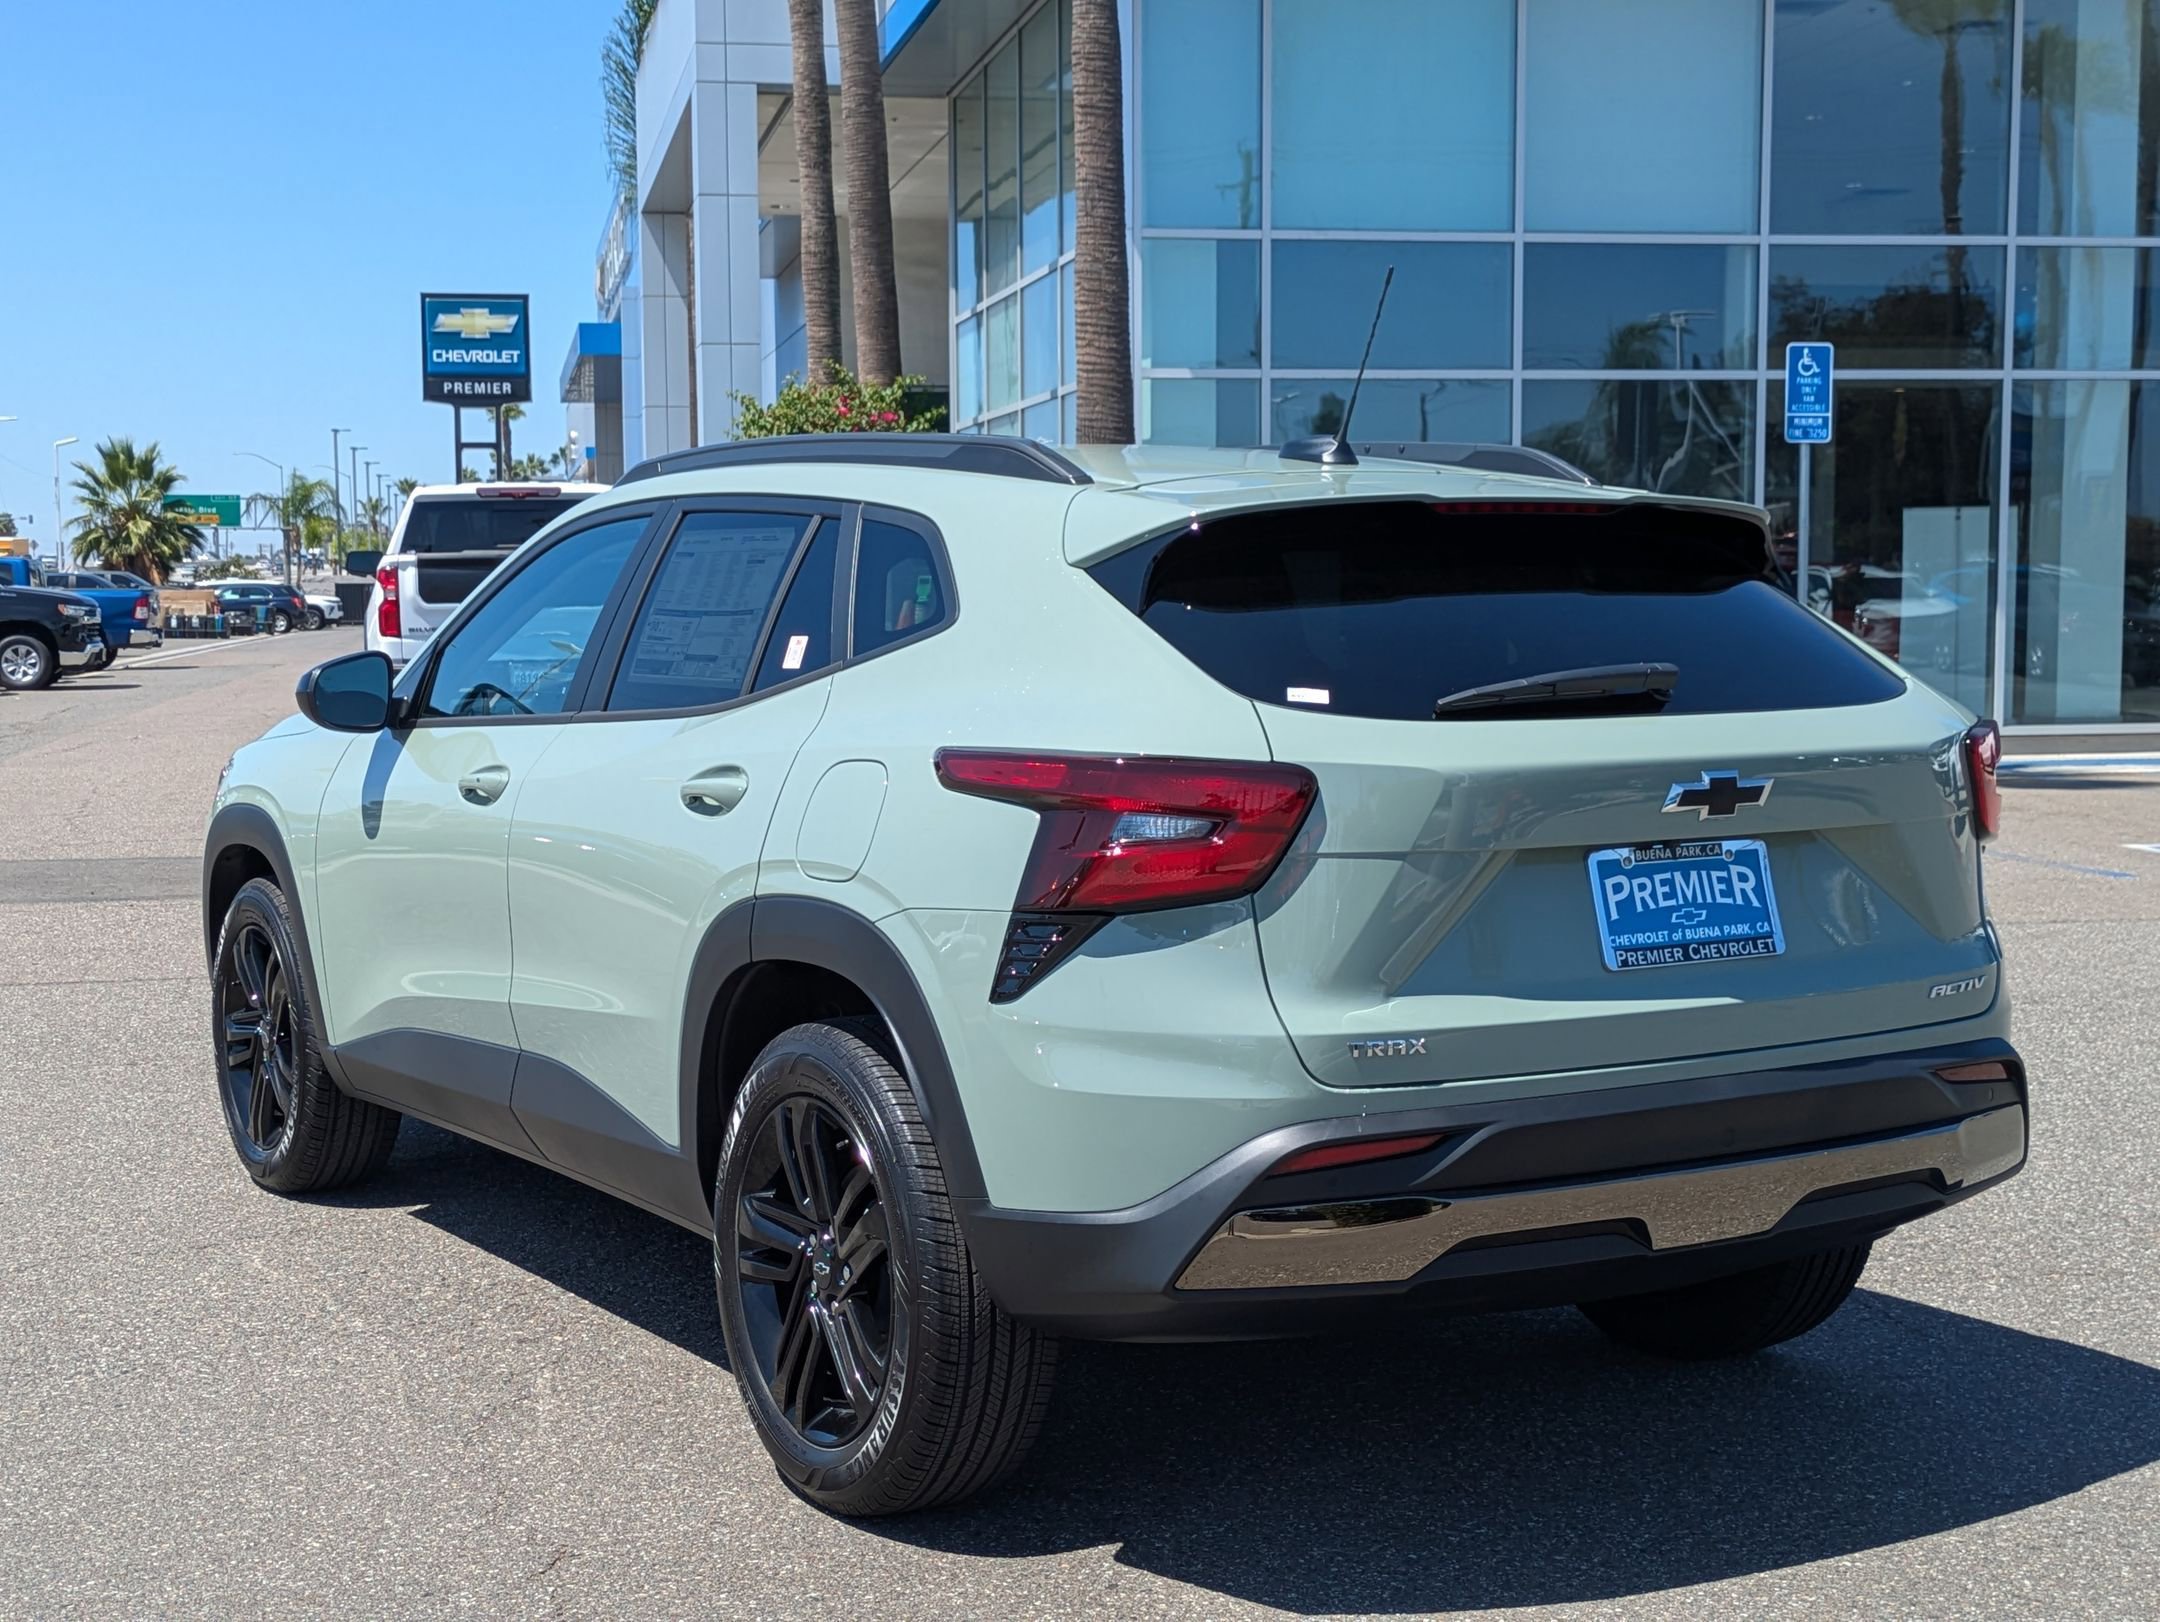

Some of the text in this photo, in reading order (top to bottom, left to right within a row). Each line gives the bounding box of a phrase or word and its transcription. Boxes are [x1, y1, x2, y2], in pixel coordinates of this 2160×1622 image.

[432, 349, 520, 363] CHEVROLET
[1796, 376, 1822, 385] PARKING
[443, 382, 512, 394] PREMIER
[1801, 386, 1816, 394] ONLY
[1791, 403, 1825, 412] ACCESSIBLE
[1793, 418, 1823, 426] MINIMUM
[1788, 428, 1804, 438] FINE
[198, 506, 217, 514] Blvd
[1635, 848, 1672, 861] BUENA
[1604, 864, 1762, 921] PREMIER
[1609, 921, 1771, 947] CHEVROLET of BUENA PARK, CA
[1616, 938, 1775, 968] PREMIER CHEVROLET
[1929, 975, 1988, 999] ACTIV
[1346, 1037, 1427, 1058] TRAX
[846, 1358, 906, 1482] ASSURANCE
